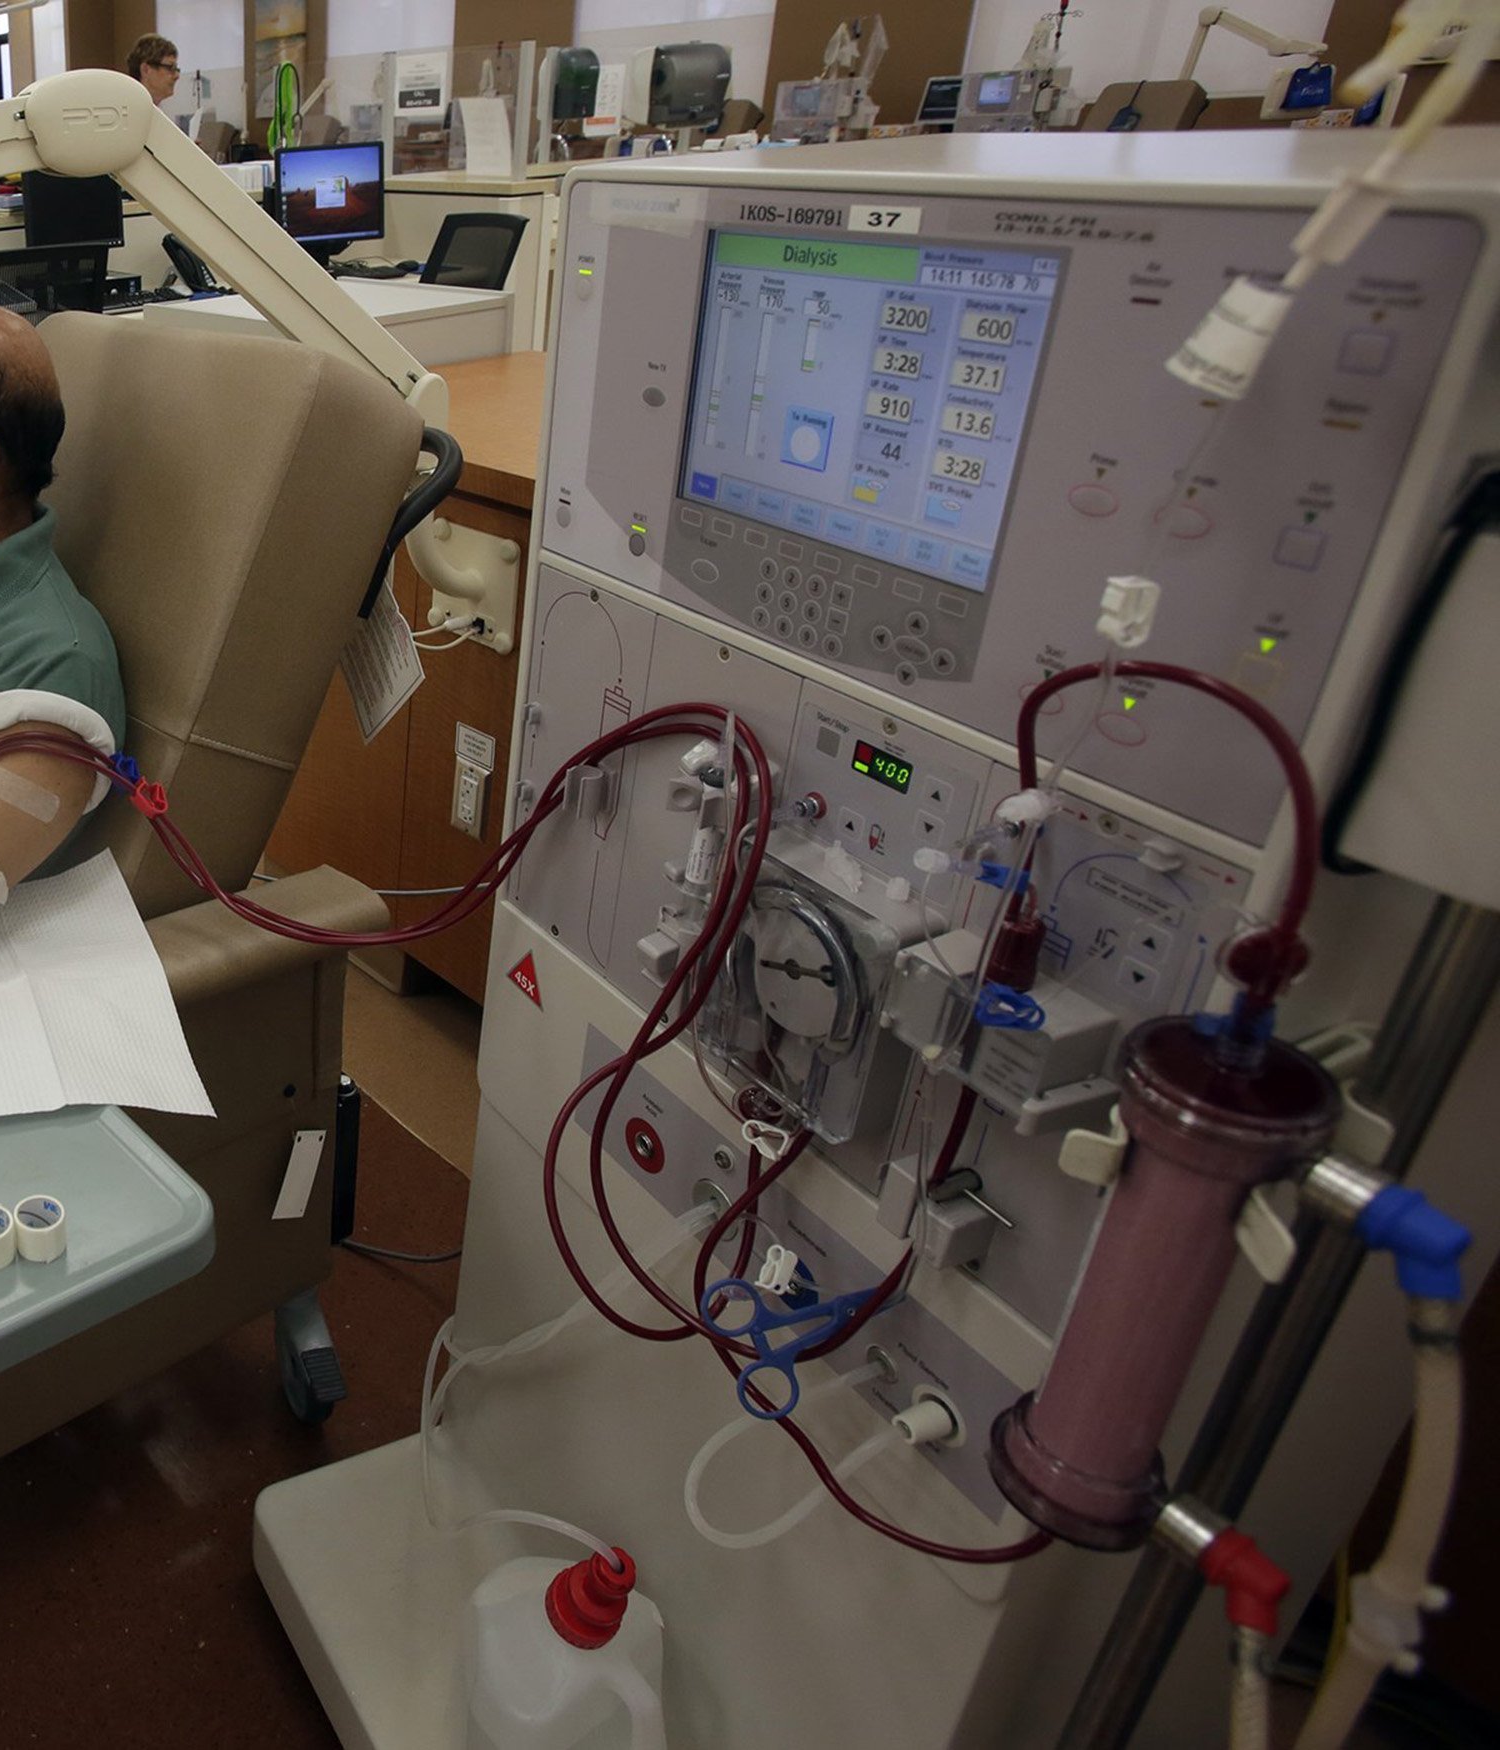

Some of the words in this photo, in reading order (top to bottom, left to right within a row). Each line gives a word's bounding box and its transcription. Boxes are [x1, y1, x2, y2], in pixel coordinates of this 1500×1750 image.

[867, 212, 902, 228] 37
[782, 244, 838, 267] Dialysis
[1023, 276, 1040, 292] 70
[766, 294, 784, 309] 170
[818, 300, 830, 315] 50
[885, 306, 928, 329] 3200
[976, 318, 1012, 340] 600
[884, 352, 919, 375] 3:28
[962, 365, 1000, 388] 37.1
[880, 396, 911, 419] 910
[955, 411, 992, 435] 13.6
[880, 442, 902, 461] 44
[943, 456, 981, 480] 3:28
[875, 757, 910, 784] 400
[514, 970, 536, 997] 45X
